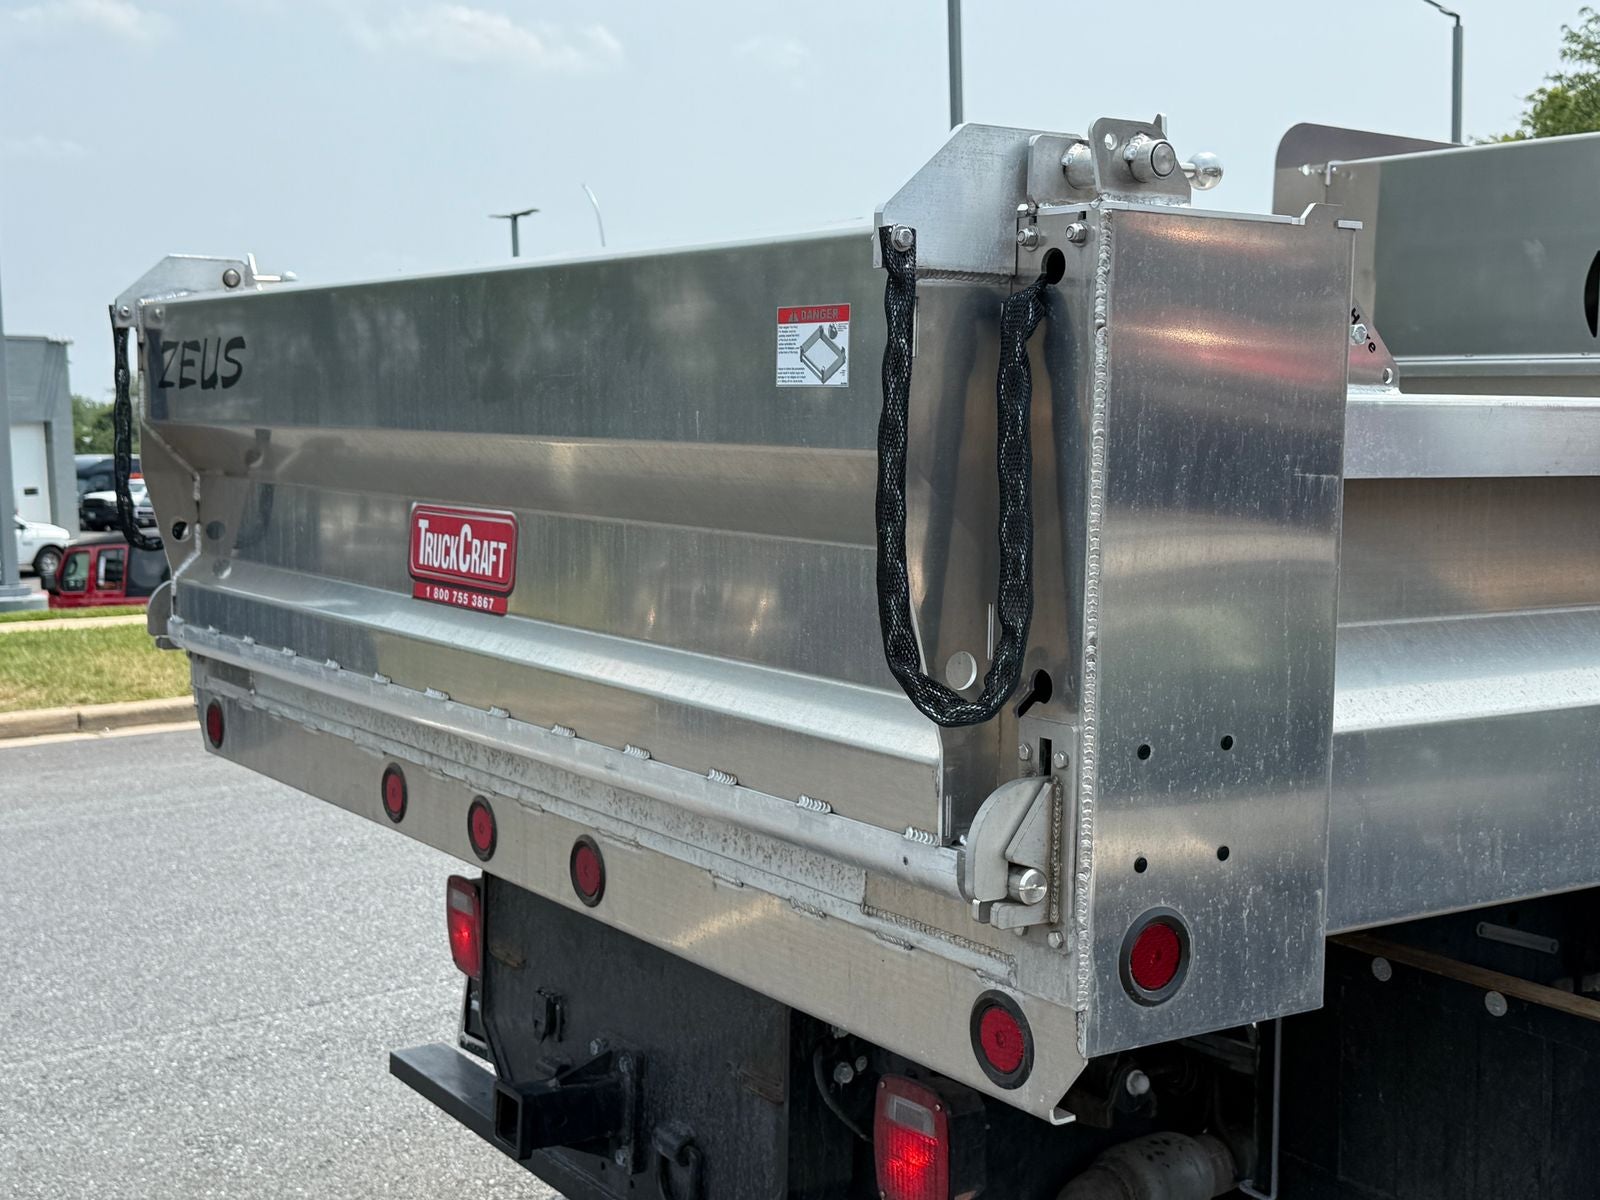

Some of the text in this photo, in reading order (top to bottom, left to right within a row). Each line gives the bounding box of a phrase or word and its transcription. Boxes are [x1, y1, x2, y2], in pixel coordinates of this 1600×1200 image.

[801, 308, 839, 321] DANGER
[158, 336, 246, 390] ZEUS
[426, 586, 495, 610] 1 800 755 3867
